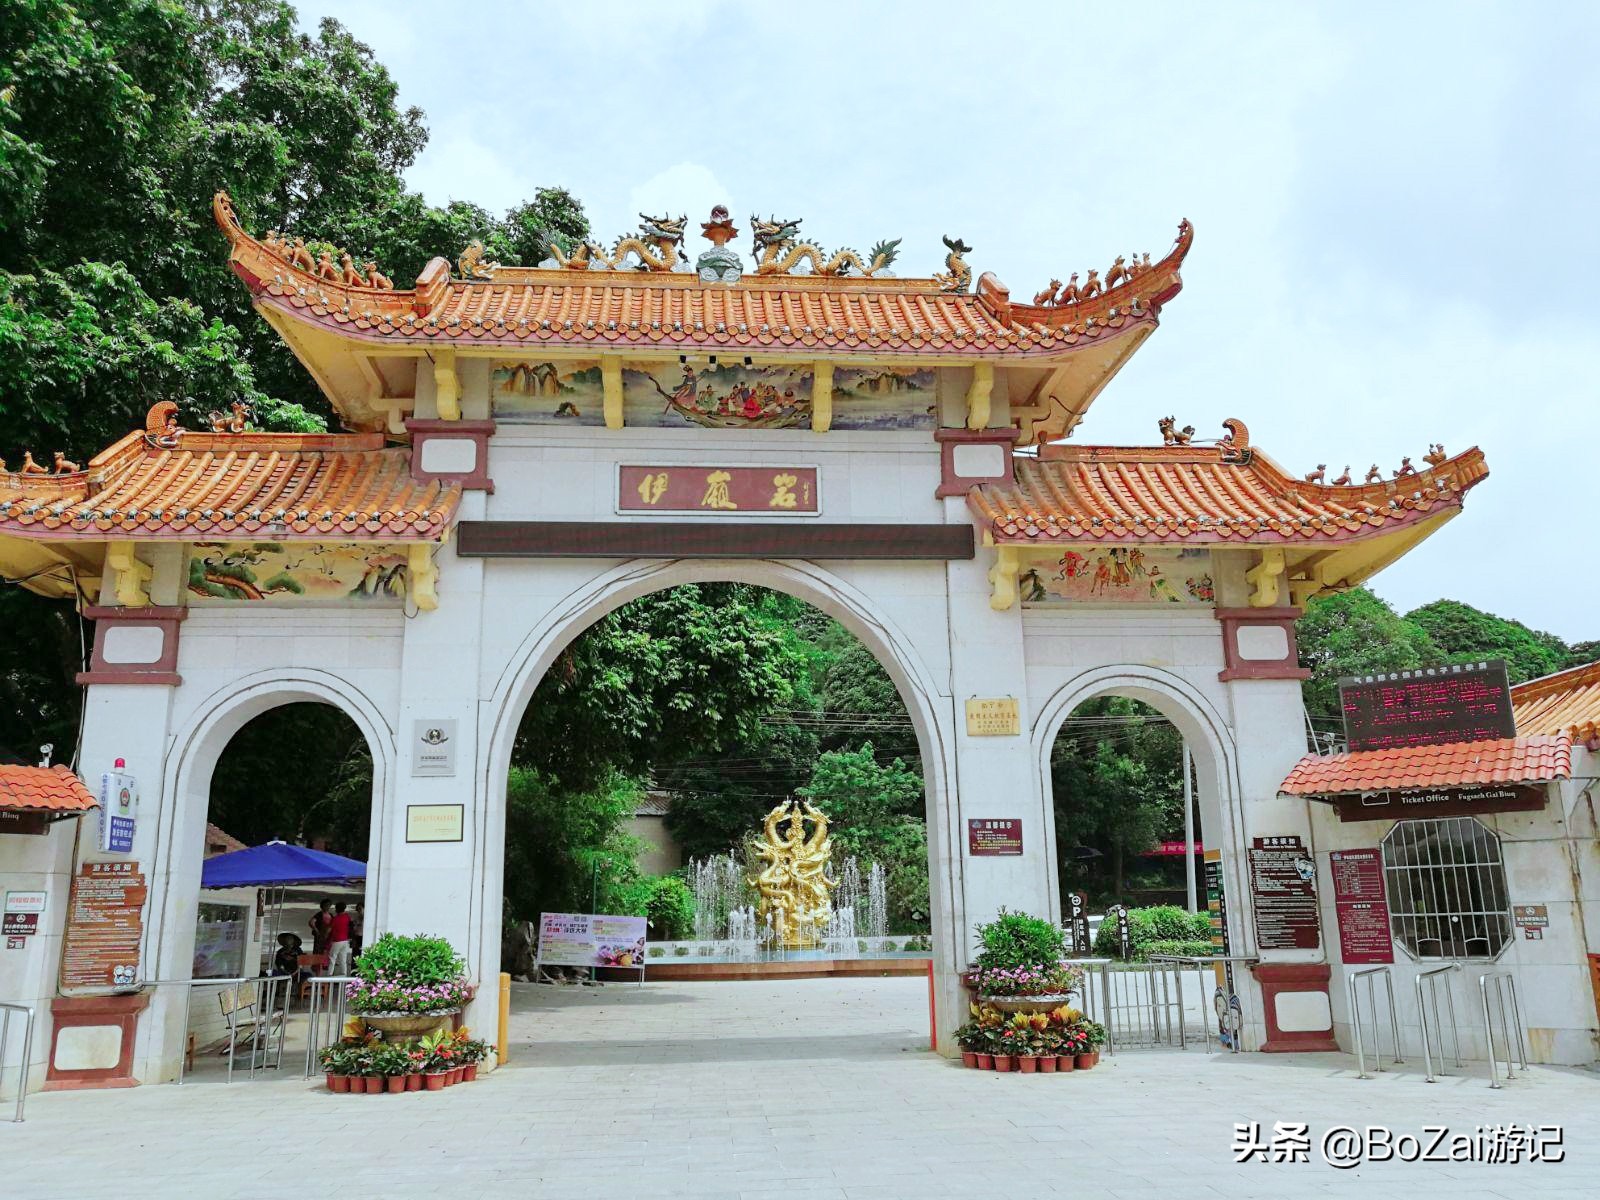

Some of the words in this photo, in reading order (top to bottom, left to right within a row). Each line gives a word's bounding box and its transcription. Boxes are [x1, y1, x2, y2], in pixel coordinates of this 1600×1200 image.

[1401, 796, 1425, 804] Ticket
[1425, 794, 1450, 802] Office
[1262, 837, 1297, 846] 游客须知
[92, 863, 132, 872] 游客须知
[1072, 906, 1082, 918] P
